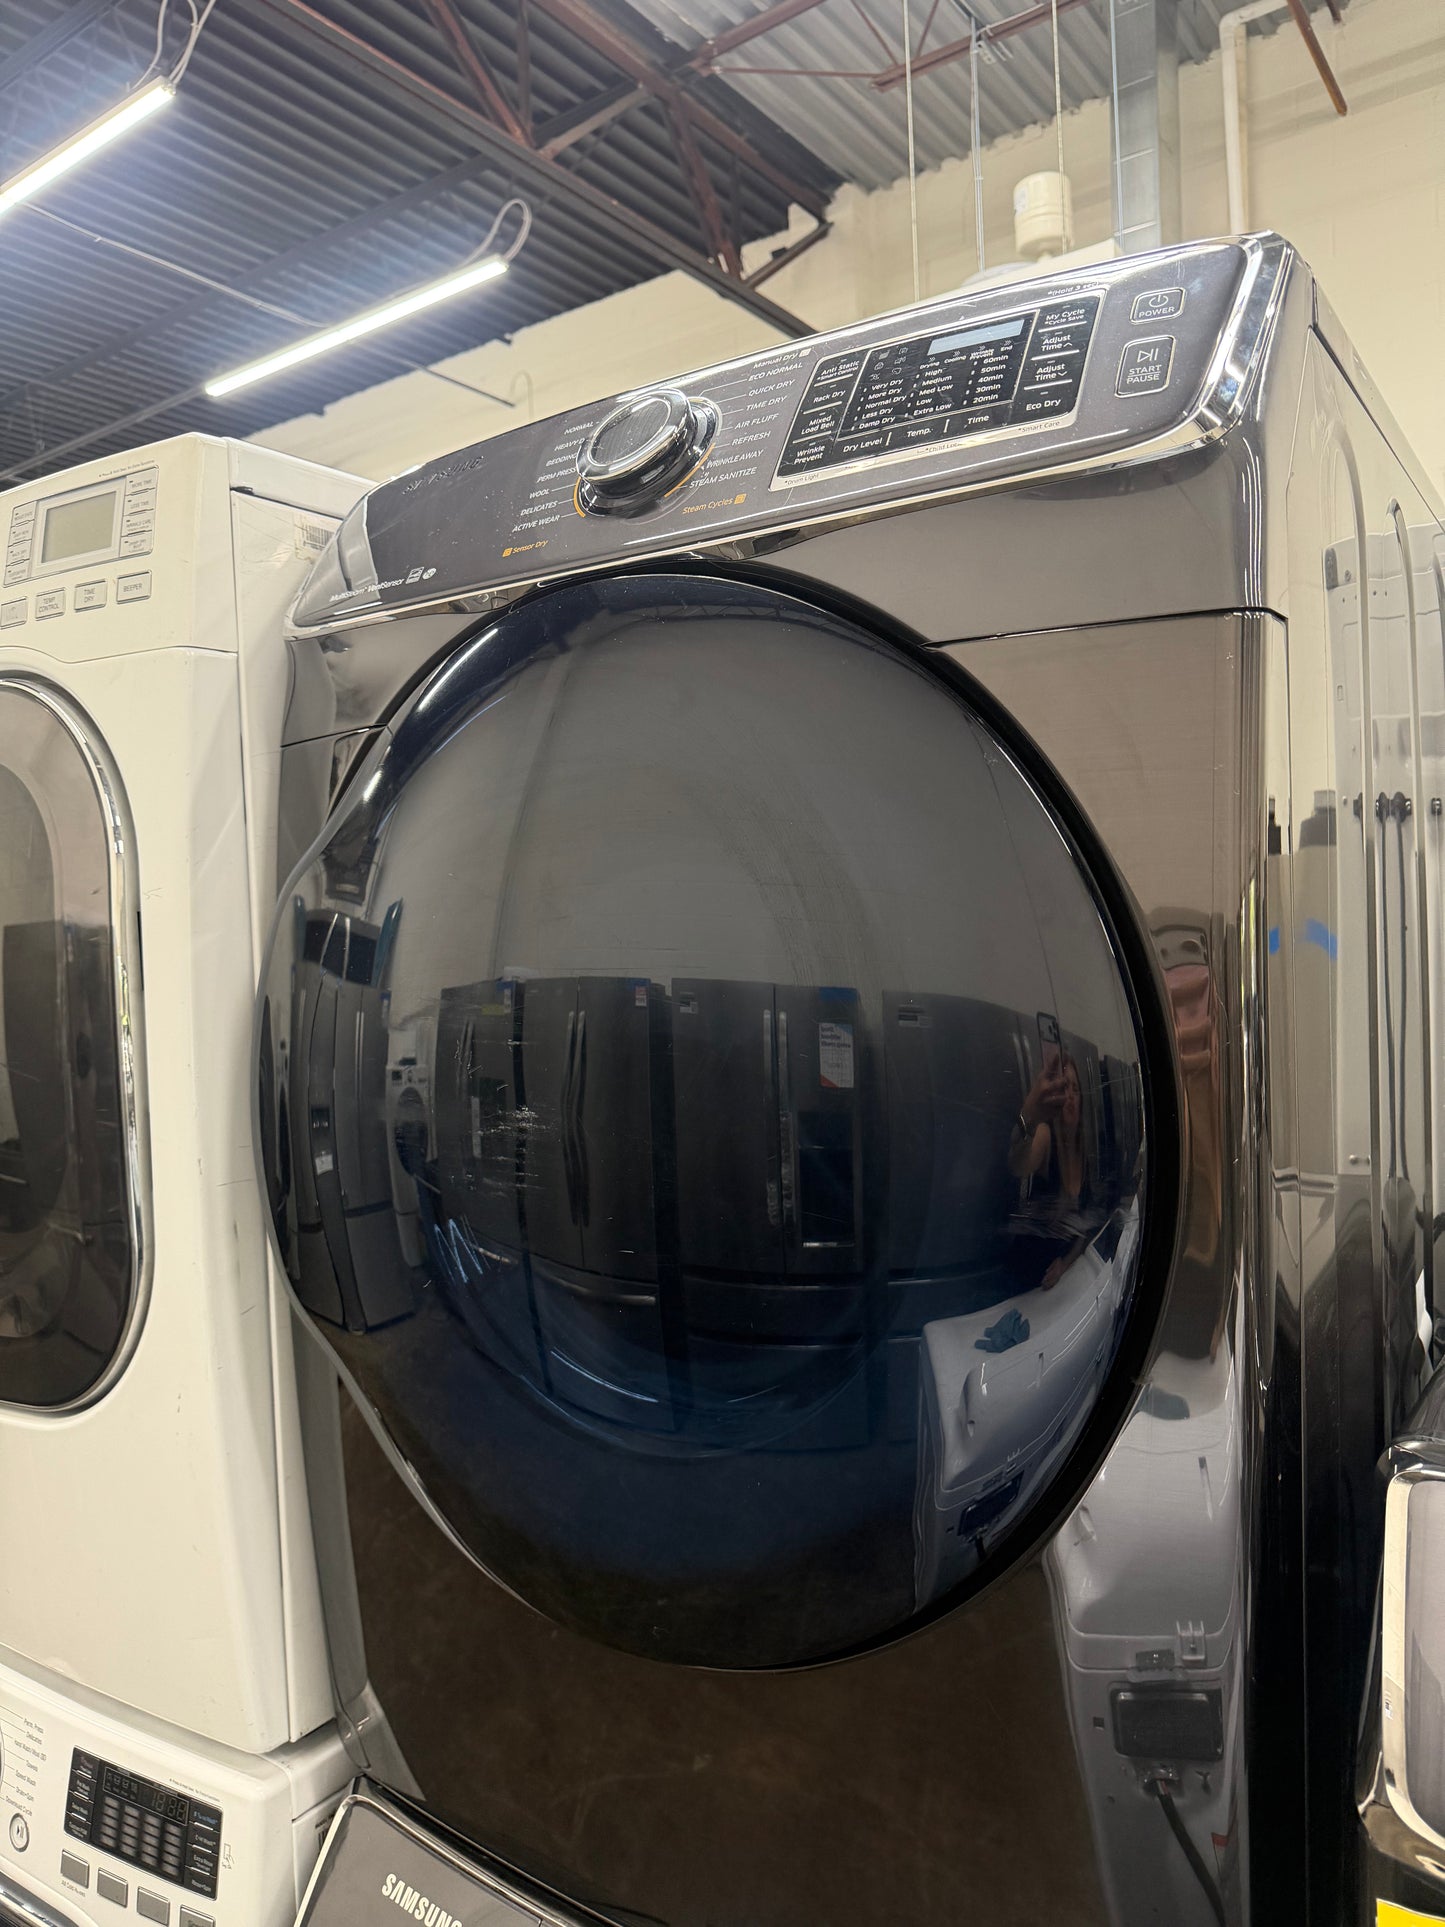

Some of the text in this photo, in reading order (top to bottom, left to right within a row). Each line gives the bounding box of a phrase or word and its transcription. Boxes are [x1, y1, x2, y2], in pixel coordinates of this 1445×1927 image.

[1046, 309, 1085, 321] My Cycle
[1138, 306, 1175, 319] POWER
[1042, 334, 1072, 345] Adjust
[1040, 342, 1063, 352] Time
[783, 353, 798, 362] Dry
[983, 354, 1009, 364] 60min
[748, 362, 803, 382] ECO NORMAL
[821, 360, 860, 376] Anti Static
[925, 369, 943, 377] High
[981, 364, 1006, 374] 50min
[1036, 363, 1066, 375] Adjust
[1128, 364, 1162, 375] START
[921, 375, 952, 386] Medium
[978, 373, 1004, 383] 40min
[1034, 371, 1057, 381] Time
[1126, 374, 1160, 384] PAUSE
[749, 379, 796, 397] QUICK DRY
[871, 379, 904, 391] Very Dry
[919, 384, 954, 396] Med Low
[975, 383, 1001, 394] 30min
[813, 390, 846, 403] Rack Dry
[868, 387, 902, 400] More Dry
[972, 393, 999, 404] 20min
[746, 395, 788, 411] TIME DRY
[865, 395, 907, 410] Normal Dry
[916, 398, 932, 406] Low
[1025, 398, 1062, 411] Eco Dry
[862, 407, 894, 419] Less Dry
[913, 403, 952, 416] Extra Low
[734, 413, 779, 430] AIR FLUFF
[809, 415, 832, 426] Mixed
[859, 416, 895, 430] Damp Dry
[967, 414, 990, 425] Time
[1044, 421, 1060, 429] Care
[564, 421, 594, 435] NORMAL
[801, 421, 835, 435] Load Bell
[907, 427, 932, 438] Temp.
[732, 431, 771, 446] REFRESH
[554, 439, 579, 451] HEAVY
[797, 445, 825, 457] Wrinkle
[843, 437, 883, 453] Dry Level
[738, 449, 764, 462] AWAY
[794, 453, 823, 465] Prevent
[536, 473, 556, 483] PERM
[689, 467, 758, 489] STEAM SANITIZE
[805, 473, 819, 482] Light
[529, 488, 549, 499] WOOL
[520, 501, 558, 516] DELICATES
[682, 497, 733, 514] Steam Cycles
[512, 515, 560, 532] ACTIVE WEAR
[512, 540, 549, 554] Sensor Dry
[84, 587, 95, 595] TIME
[123, 583, 142, 592] BEEPER
[39, 602, 60, 612] CONTROL
